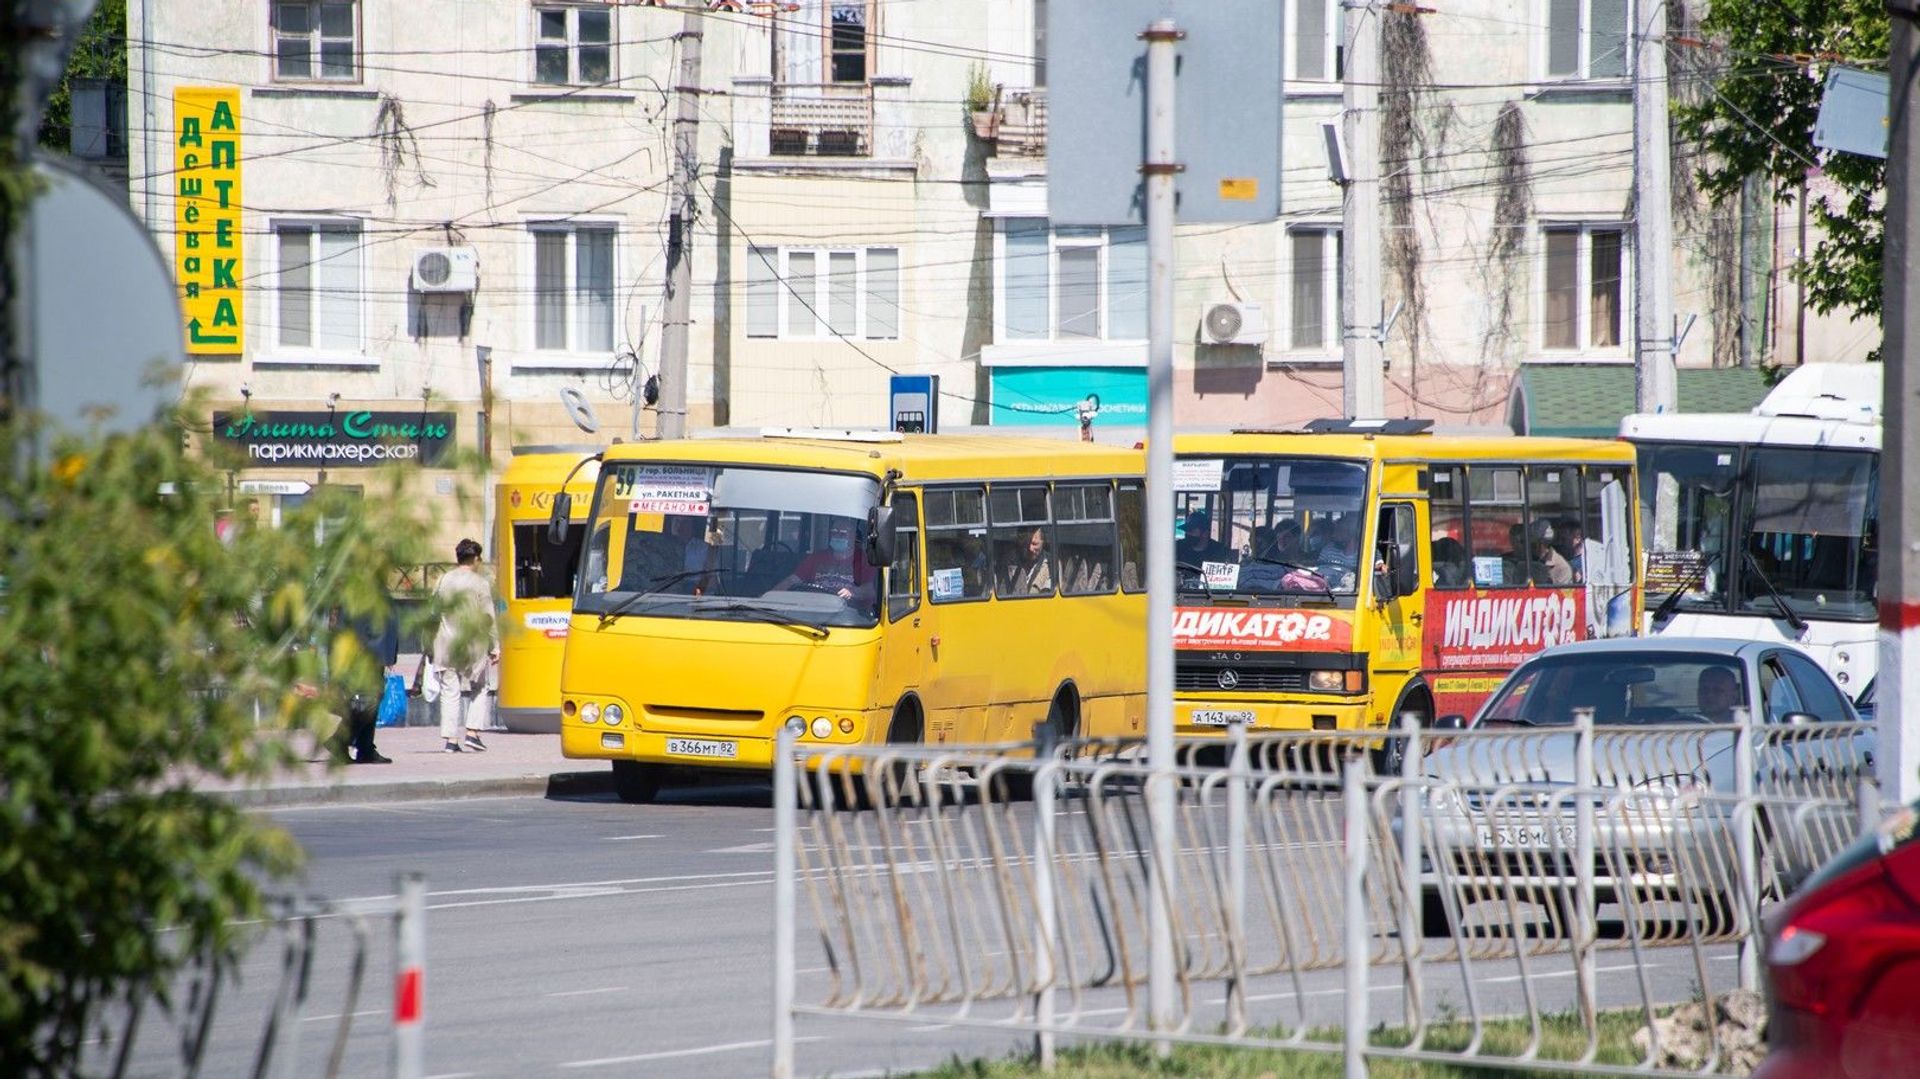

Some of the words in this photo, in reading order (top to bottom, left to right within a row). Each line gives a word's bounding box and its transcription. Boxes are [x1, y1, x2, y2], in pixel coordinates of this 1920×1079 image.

[180, 117, 202, 298] Дешёвая
[210, 101, 237, 326] АПТЕКА
[1096, 404, 1146, 413] ОСМЕТИКИ
[343, 410, 449, 438] Стиль
[248, 442, 419, 462] парикмахерская
[616, 467, 635, 495] 59
[662, 467, 706, 475] БОЛЬНИЦА
[656, 490, 701, 499] РАКЕТНАЯ
[641, 502, 696, 512] МЕГАНОМ
[1443, 594, 1576, 649] ИНДИКАТОР
[720, 742, 733, 753] 82
